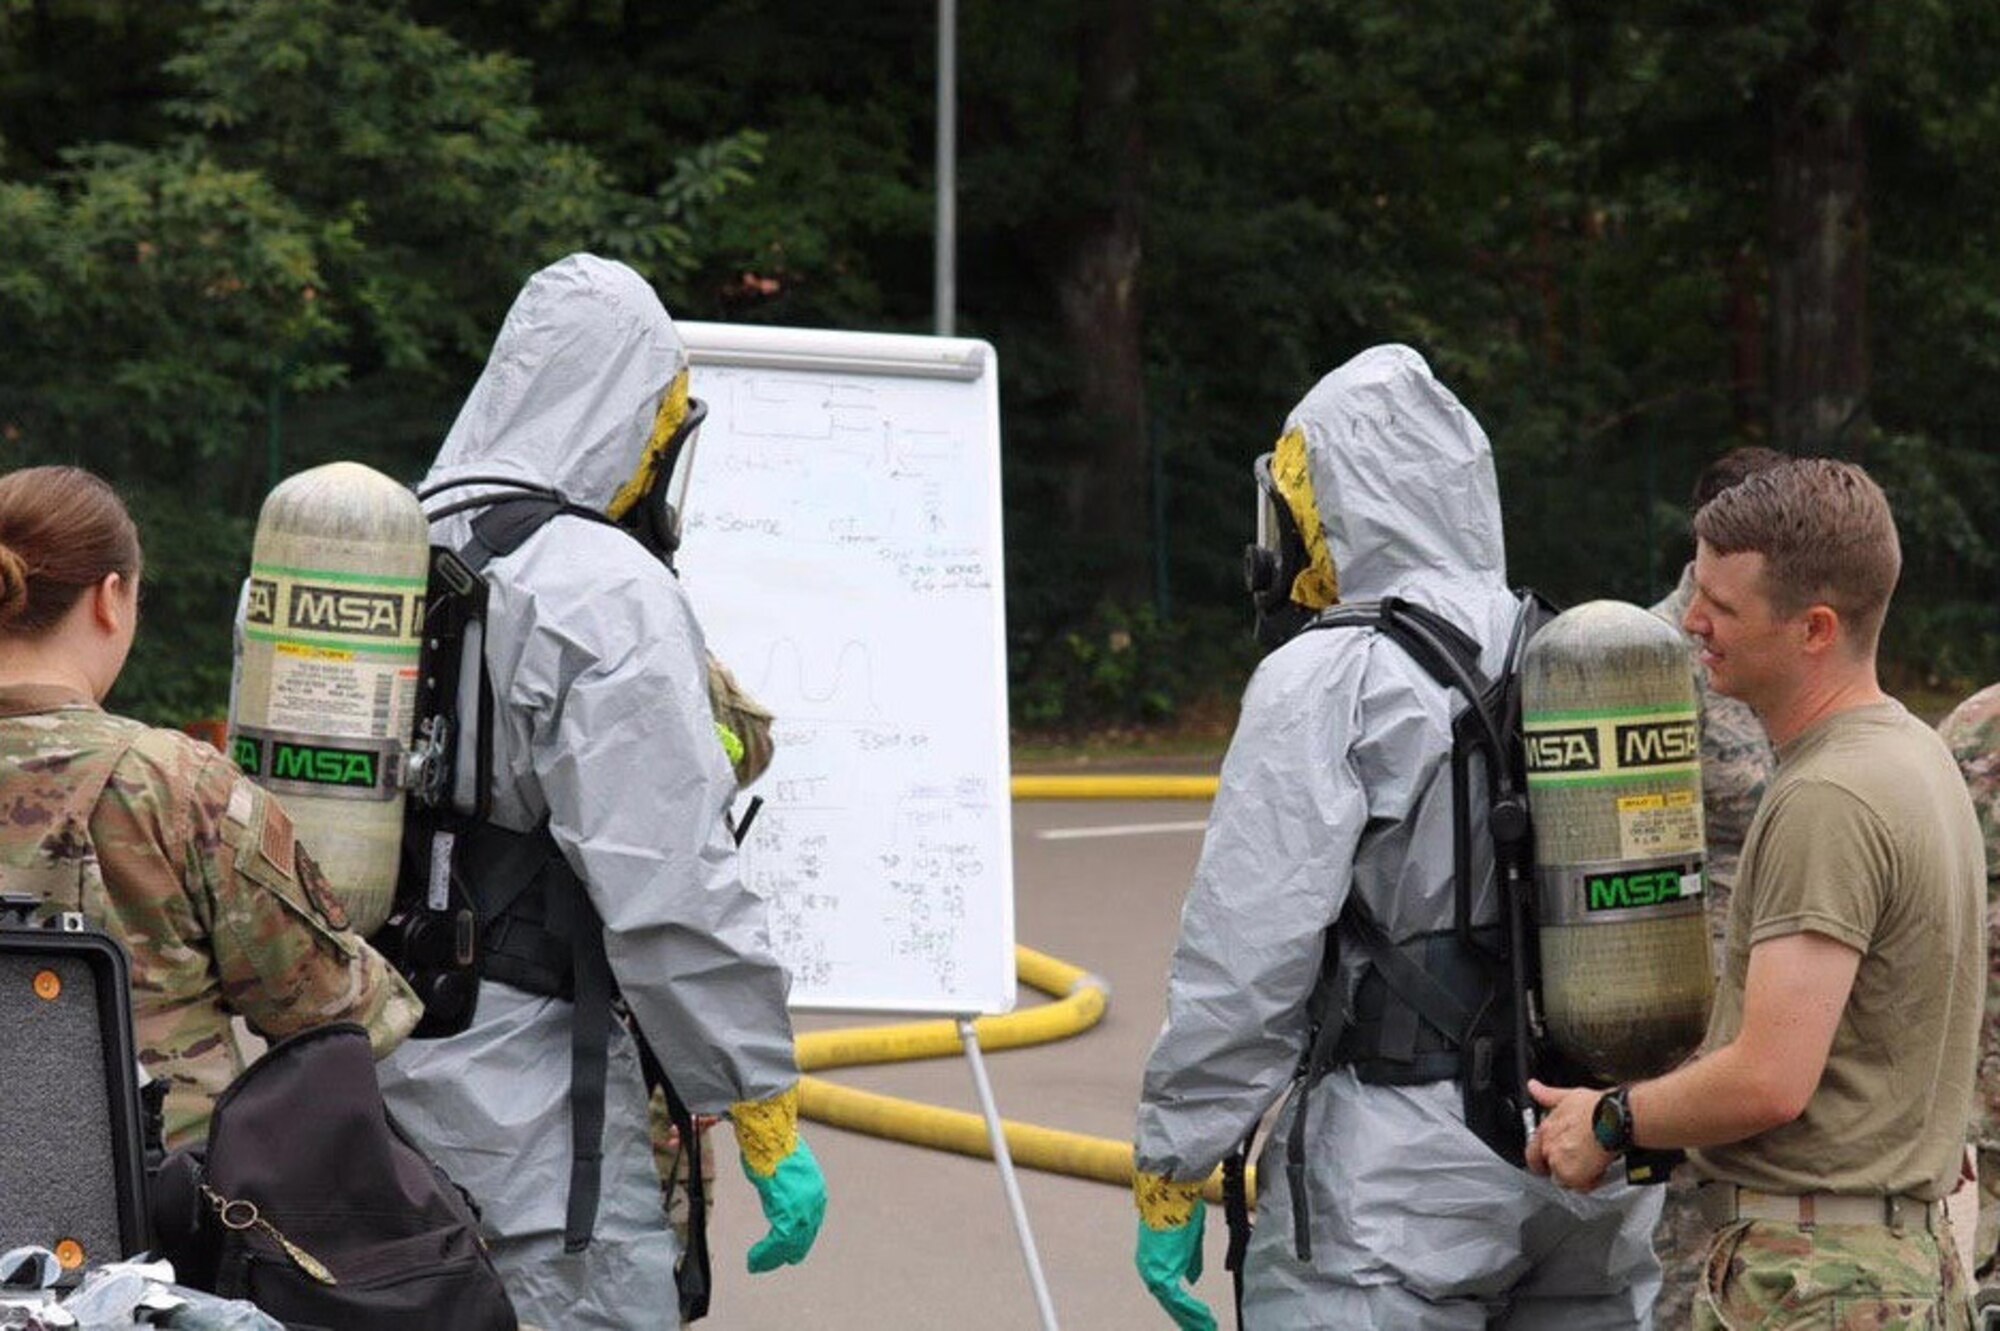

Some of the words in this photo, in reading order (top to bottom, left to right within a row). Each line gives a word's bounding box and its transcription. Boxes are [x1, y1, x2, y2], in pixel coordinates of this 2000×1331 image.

[294, 591, 399, 631] MSA
[276, 745, 374, 785] MSA
[1590, 871, 1682, 909] MSA
